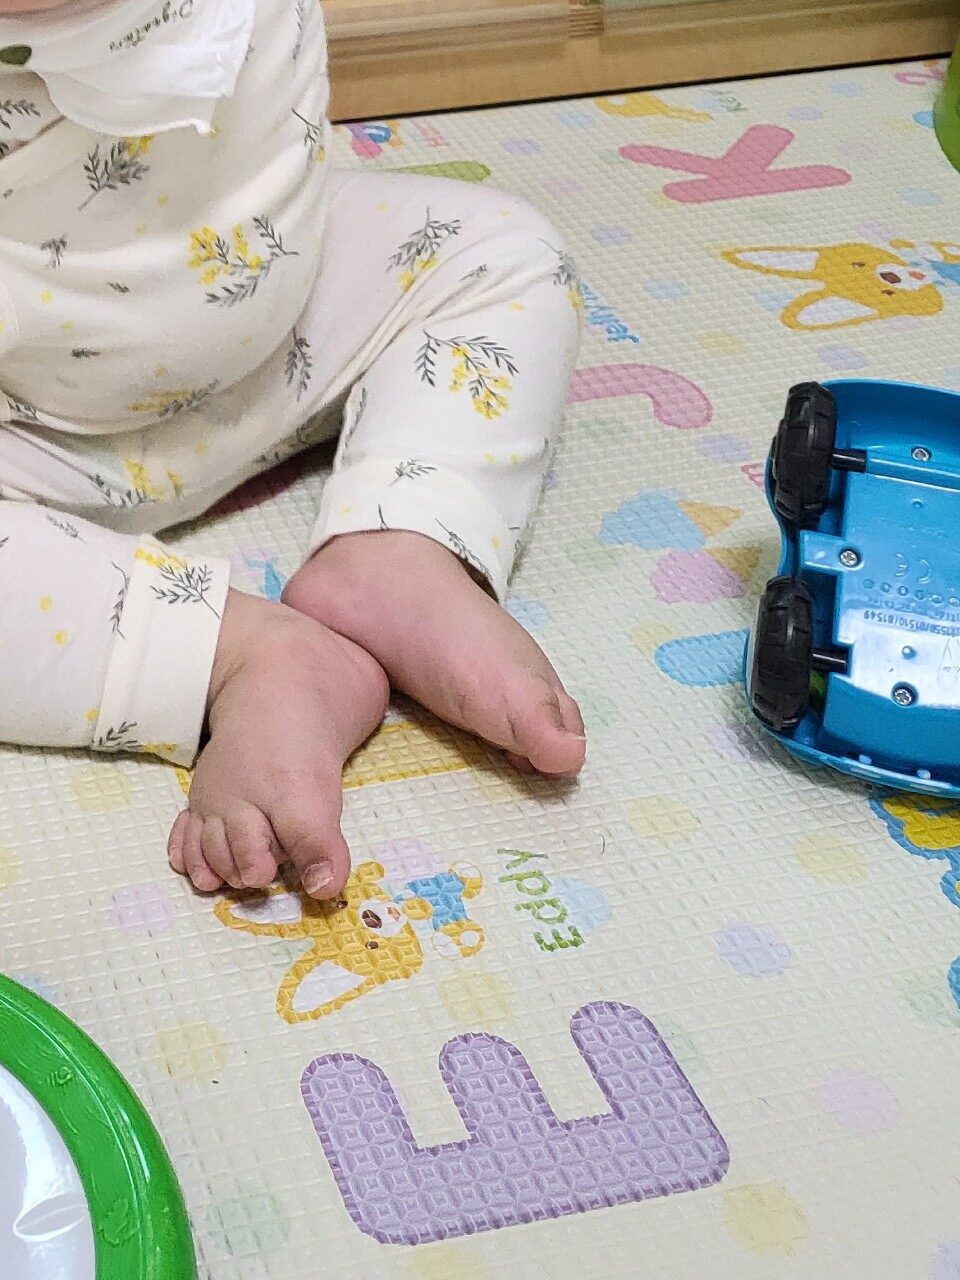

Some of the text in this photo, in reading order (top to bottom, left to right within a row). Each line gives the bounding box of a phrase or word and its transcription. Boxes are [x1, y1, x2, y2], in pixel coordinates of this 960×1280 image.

[617, 124, 851, 204] K
[495, 846, 584, 953] Eddy
[298, 1000, 732, 1246] E
